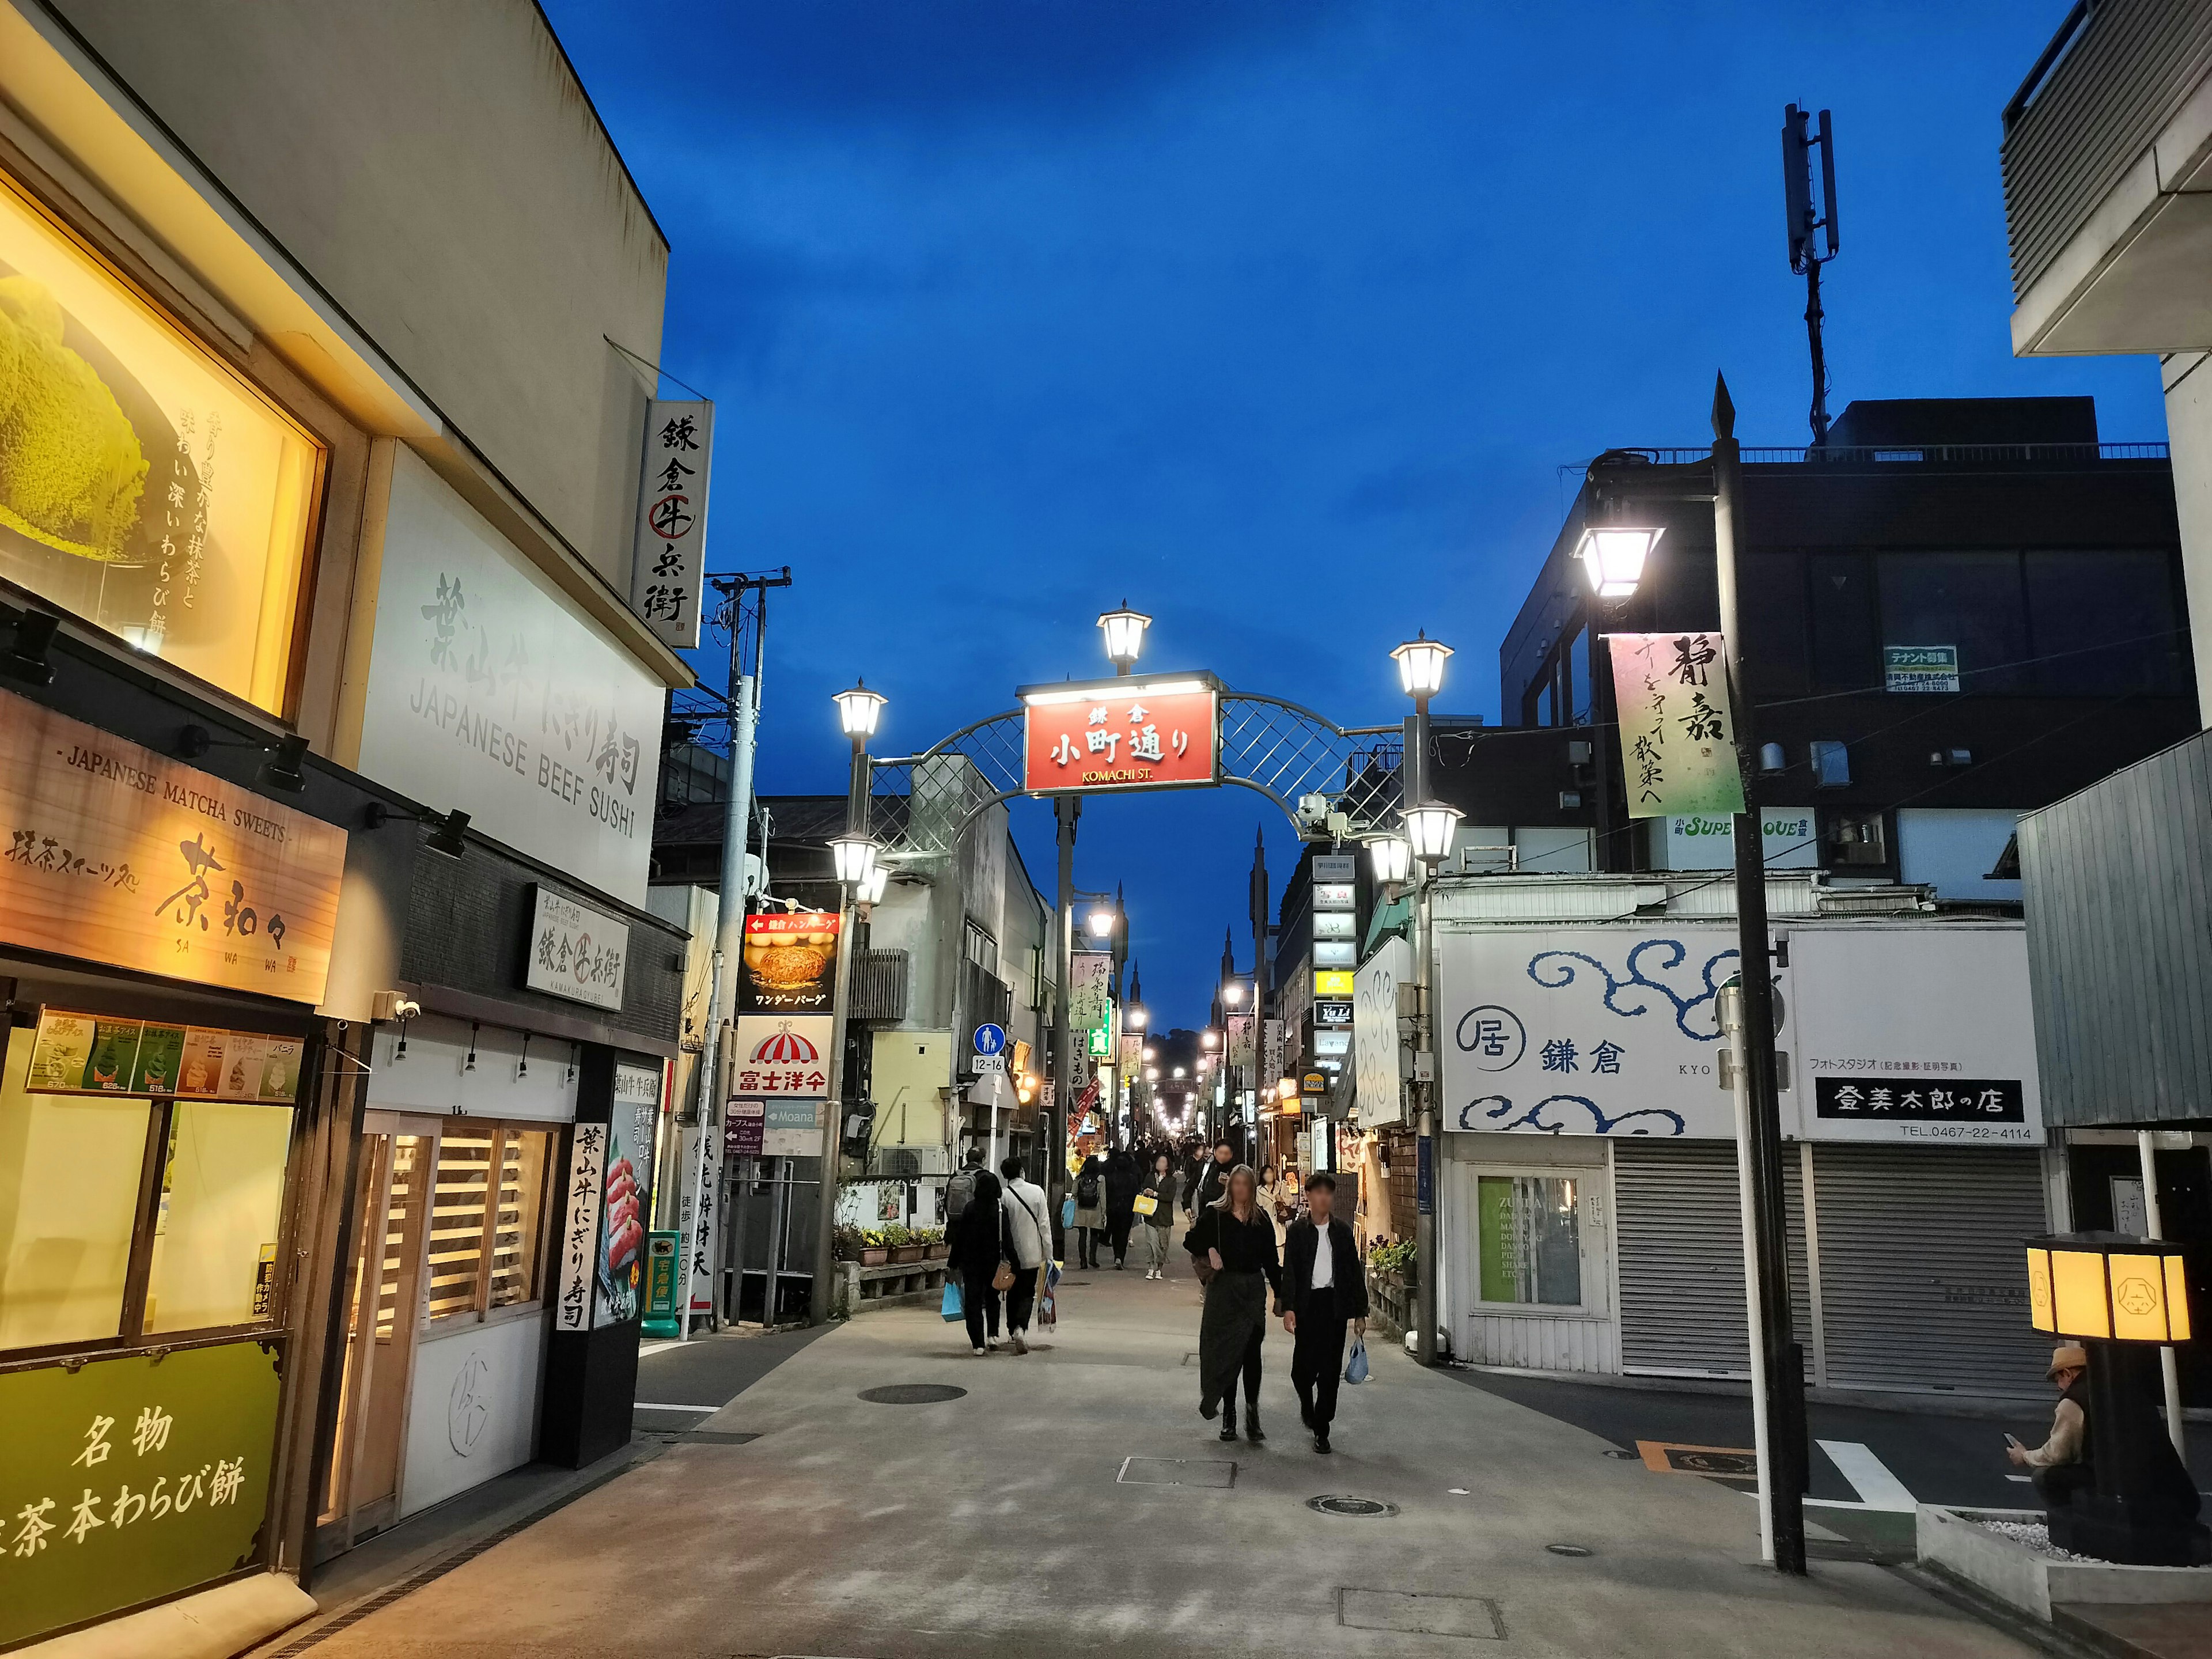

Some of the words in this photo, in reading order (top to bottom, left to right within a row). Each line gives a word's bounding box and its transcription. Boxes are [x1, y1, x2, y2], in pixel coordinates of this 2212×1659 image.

[149, 407, 196, 636] 味わい深いわらび餅
[182, 410, 222, 609] 香り豊かな抹茶と
[1088, 703, 1149, 726] 鎌倉
[410, 677, 528, 776] JAPANESE
[537, 753, 584, 805] BEEF
[589, 787, 634, 839] SUSHI
[1050, 724, 1188, 766] 小町通り
[1082, 769, 1135, 782] KOMACHI
[1138, 768, 1154, 779] ST.
[67, 746, 157, 795] JAPANESE
[163, 781, 227, 821] MATCHA
[233, 809, 286, 843] SWEETS
[5, 829, 140, 894] 抹茶スイーツ処
[176, 938, 189, 954] SA
[225, 952, 238, 965] WA
[265, 959, 276, 973] WA
[755, 993, 827, 1006] ワンダーバーグ
[272, 1044, 294, 1055] バニラ
[976, 1059, 1001, 1070] 12-16
[1071, 1036, 1085, 1085] はきもの
[1539, 1039, 1626, 1075] 鎌倉
[1809, 1059, 1878, 1070] フォトスタジオ
[1834, 1085, 2005, 1112] 登美太郎の店
[778, 1111, 814, 1123] Moana
[1900, 1125, 2032, 1139] TEL.0467-22-4114
[563, 1125, 605, 1328] 葉山牛にぎり寿司
[71, 1405, 173, 1468] 名物
[0, 1455, 245, 1558] 茶本わらび餅
